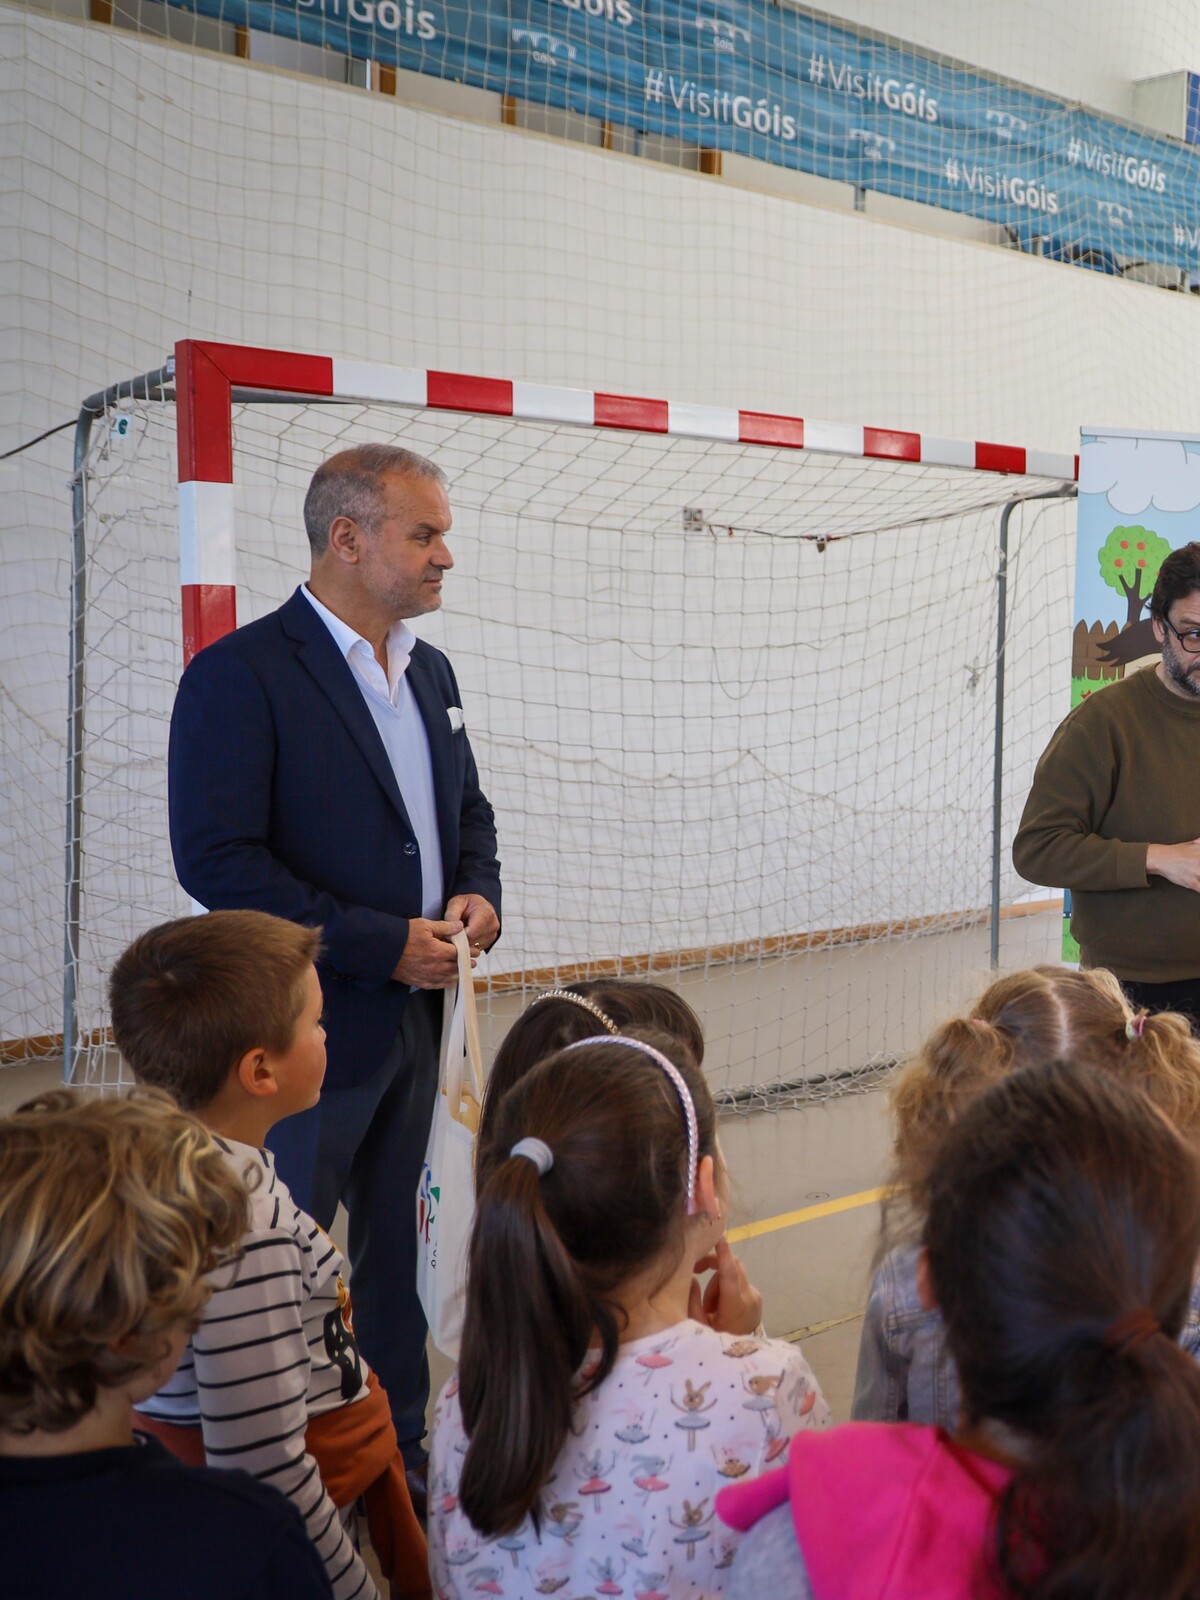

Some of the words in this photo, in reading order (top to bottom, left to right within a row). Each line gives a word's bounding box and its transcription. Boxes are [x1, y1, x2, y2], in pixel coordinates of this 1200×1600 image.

[644, 69, 797, 141] #VisitGóis
[808, 51, 939, 123] #VisitGóis
[946, 158, 1058, 214] #VisitGóis
[1068, 137, 1167, 193] #VisitGóis
